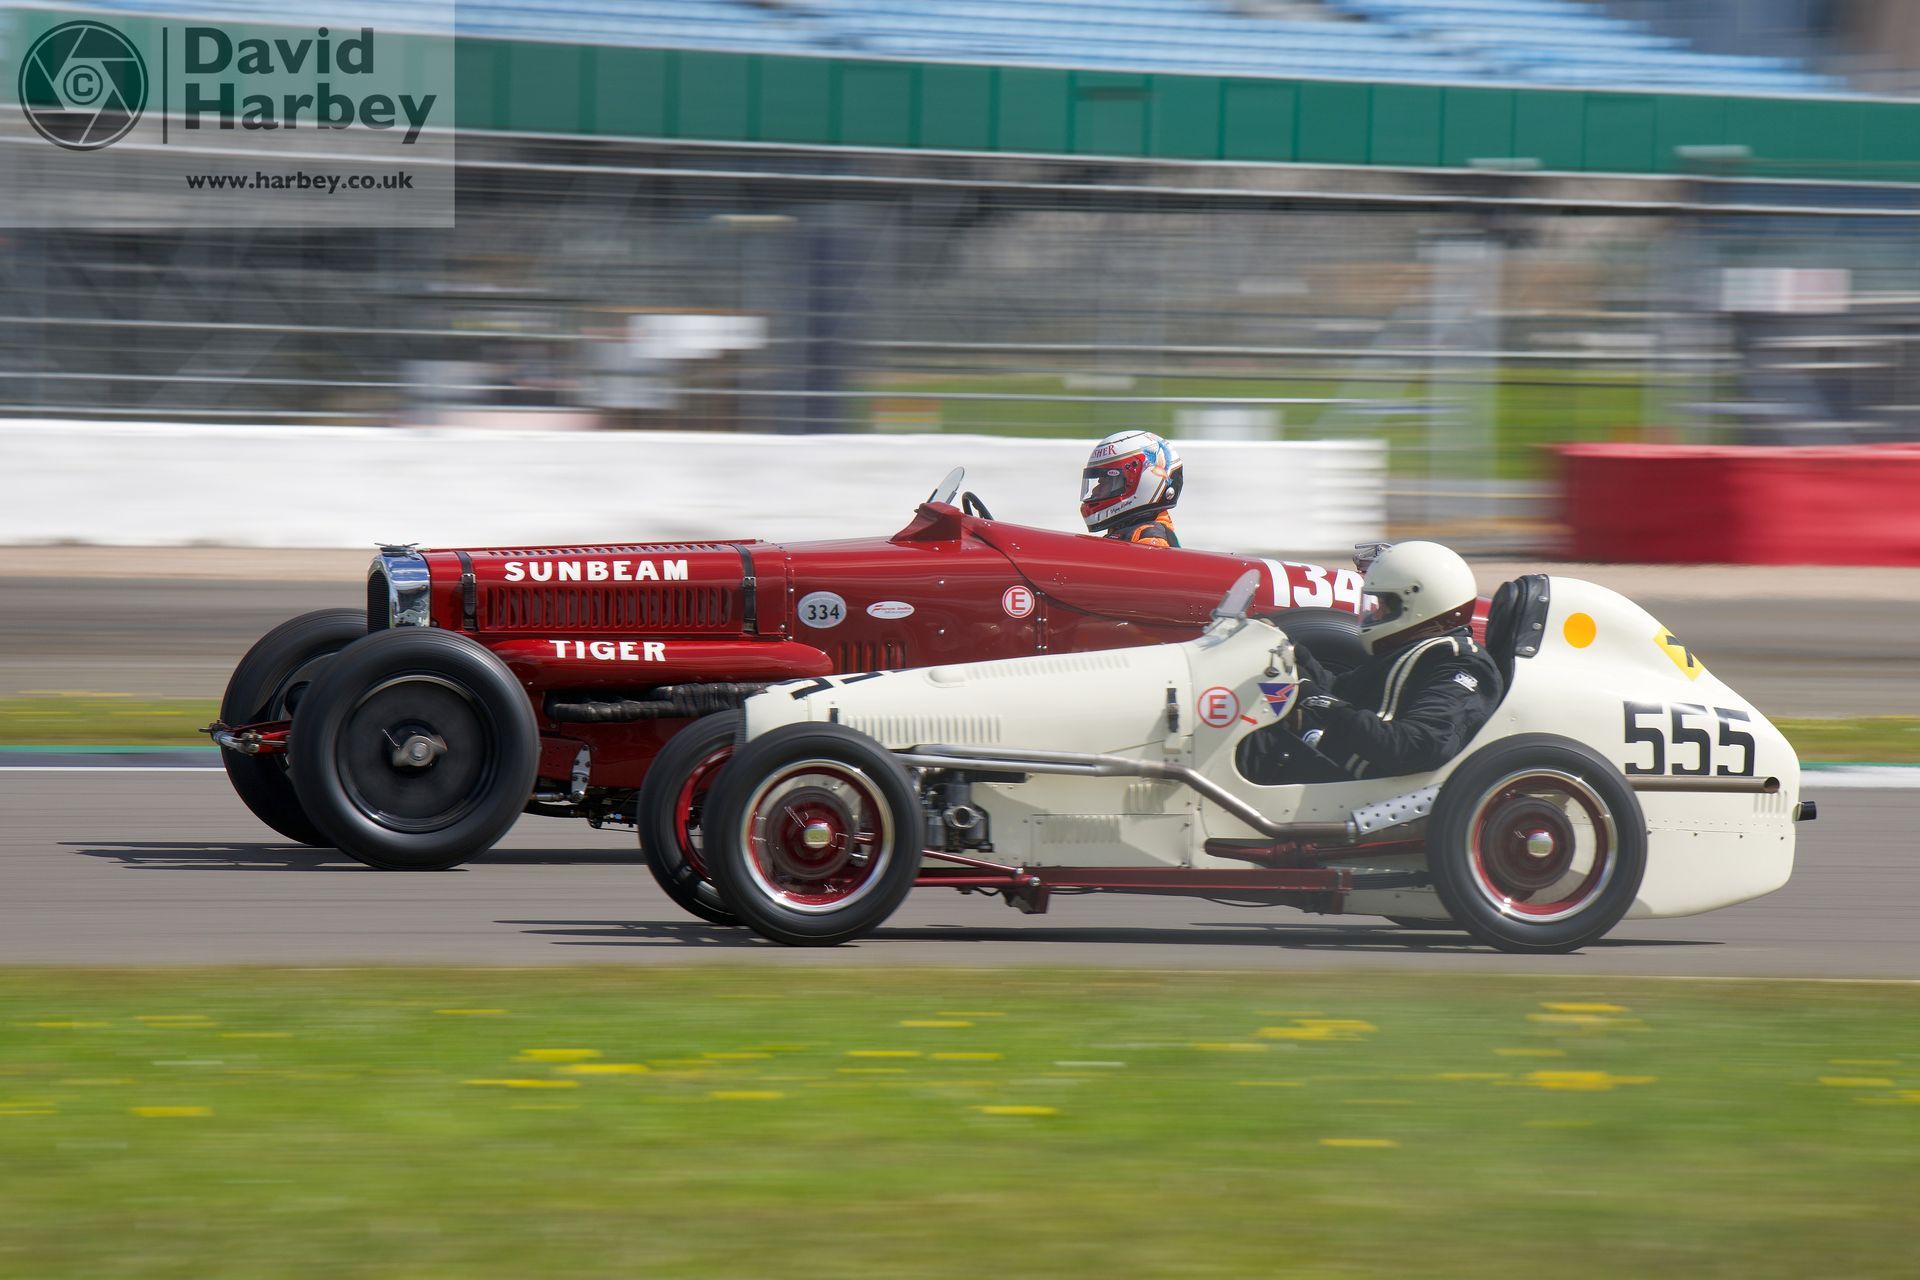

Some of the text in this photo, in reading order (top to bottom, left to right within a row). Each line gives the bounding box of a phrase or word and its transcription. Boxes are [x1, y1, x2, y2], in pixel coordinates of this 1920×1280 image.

[504, 559, 689, 581] SUNBEAM
[1260, 558, 1365, 615] 134
[808, 604, 840, 620] 334
[1011, 591, 1026, 610] E
[549, 639, 666, 662] TIGER
[1208, 694, 1228, 719] E
[1623, 700, 1755, 776] 555
